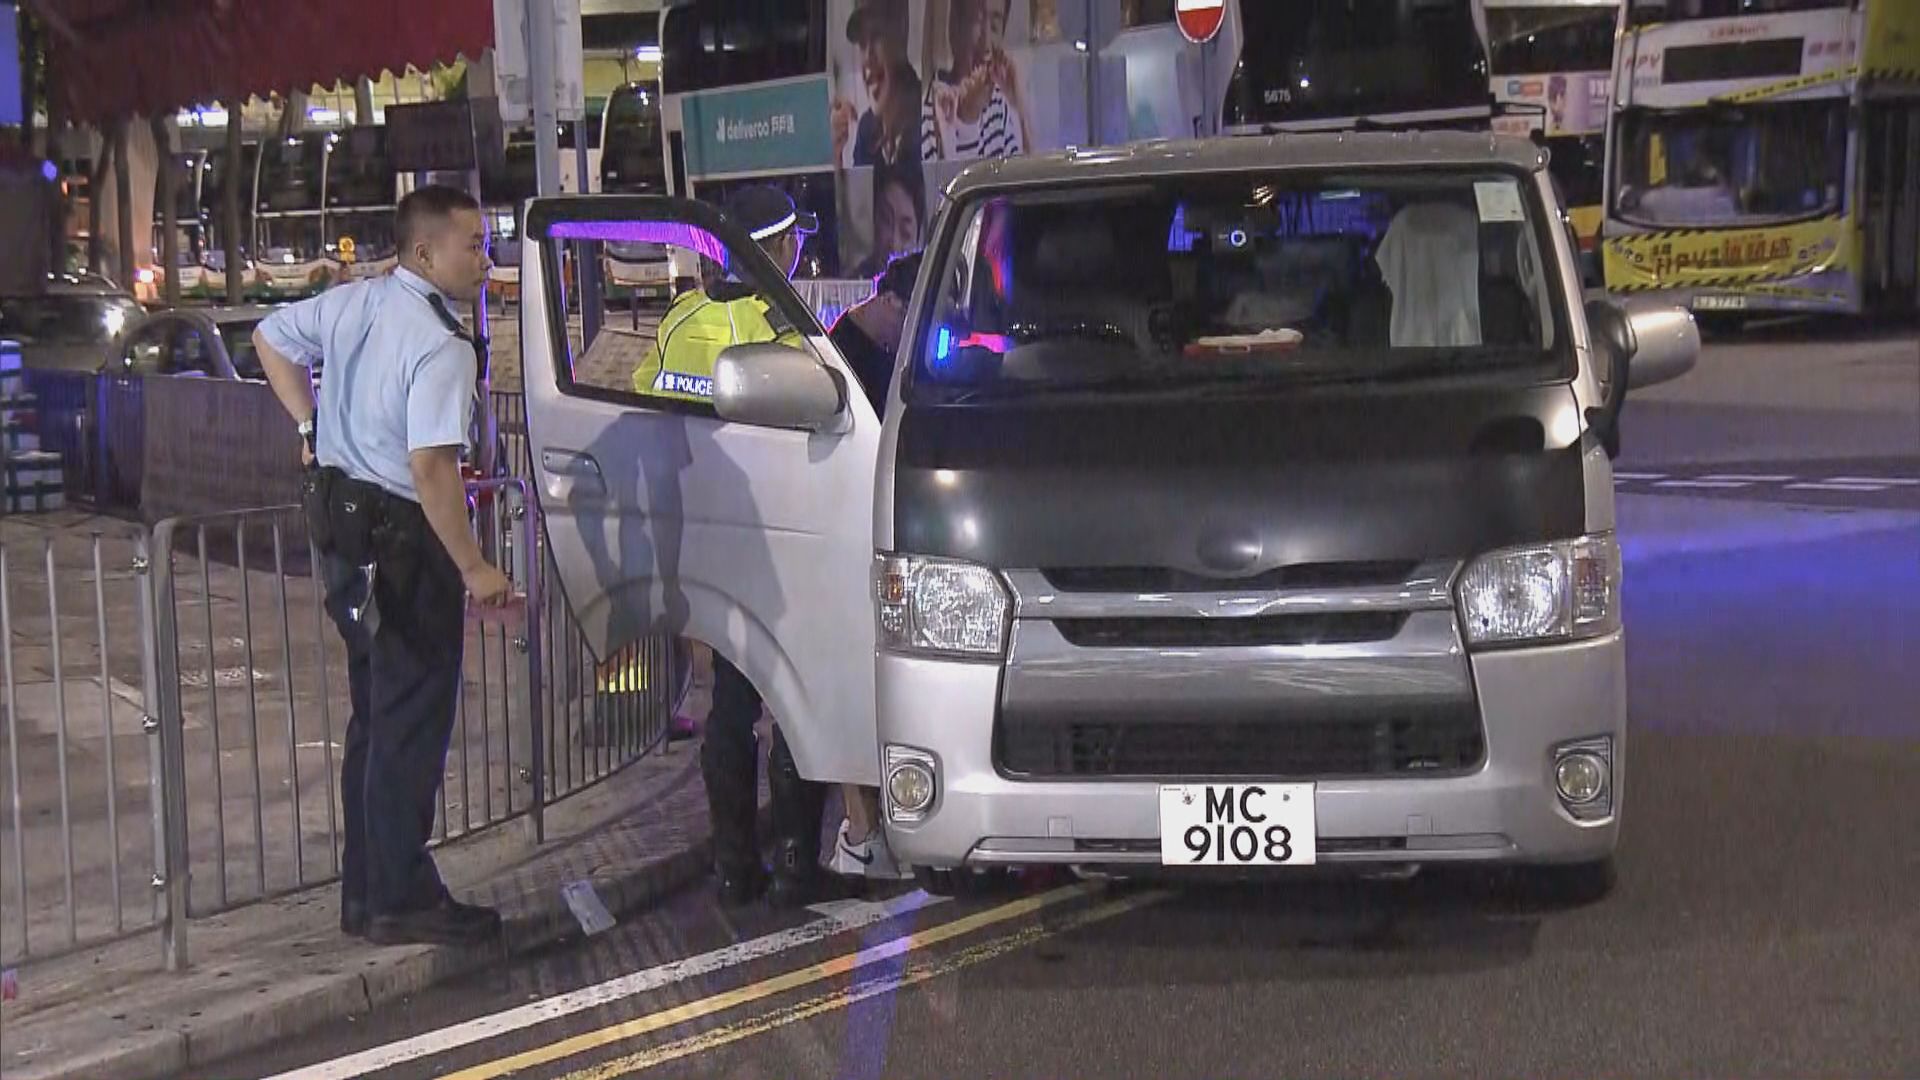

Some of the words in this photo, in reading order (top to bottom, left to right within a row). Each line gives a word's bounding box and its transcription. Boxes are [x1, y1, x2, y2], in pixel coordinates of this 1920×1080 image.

[727, 120, 769, 139] deliveroo
[677, 376, 713, 395] POLICE
[1206, 786, 1267, 823] MC
[1184, 825, 1292, 861] 9108
